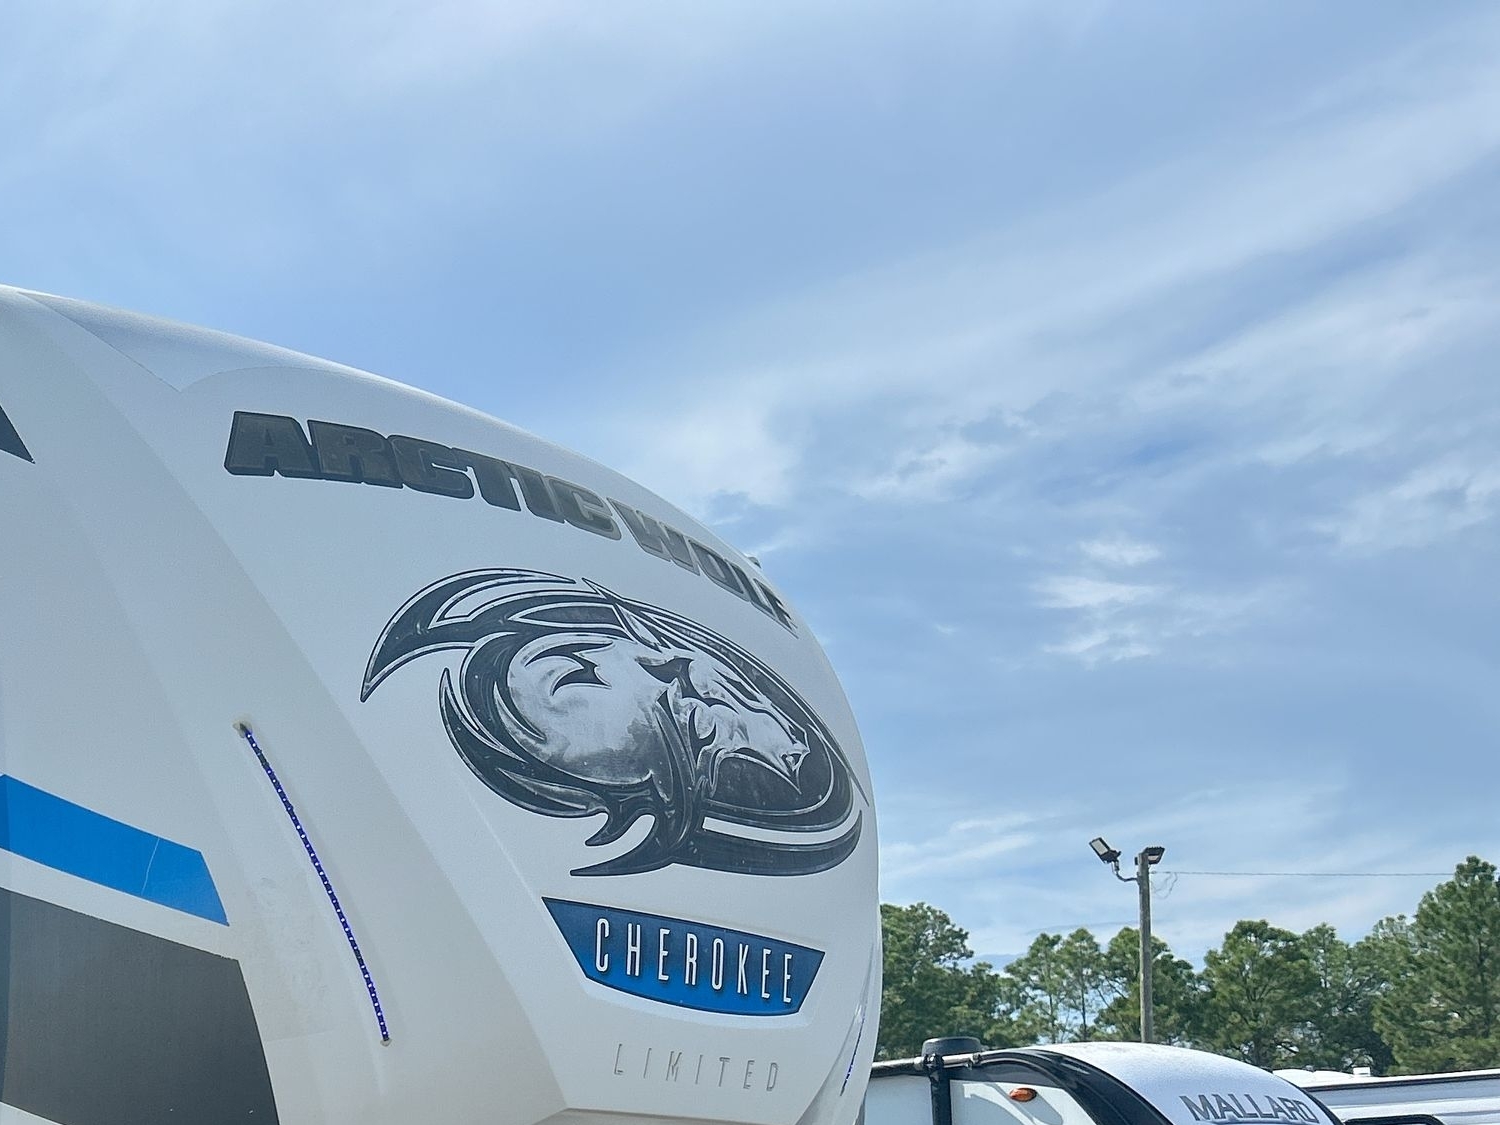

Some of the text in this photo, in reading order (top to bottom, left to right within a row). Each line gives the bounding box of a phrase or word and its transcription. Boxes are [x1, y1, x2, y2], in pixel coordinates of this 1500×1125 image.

[224, 411, 622, 541] ARCTIC
[595, 918, 793, 1003] CHEROKEE
[613, 1043, 779, 1092] LIMITED
[1179, 1093, 1320, 1125] MALLARD
